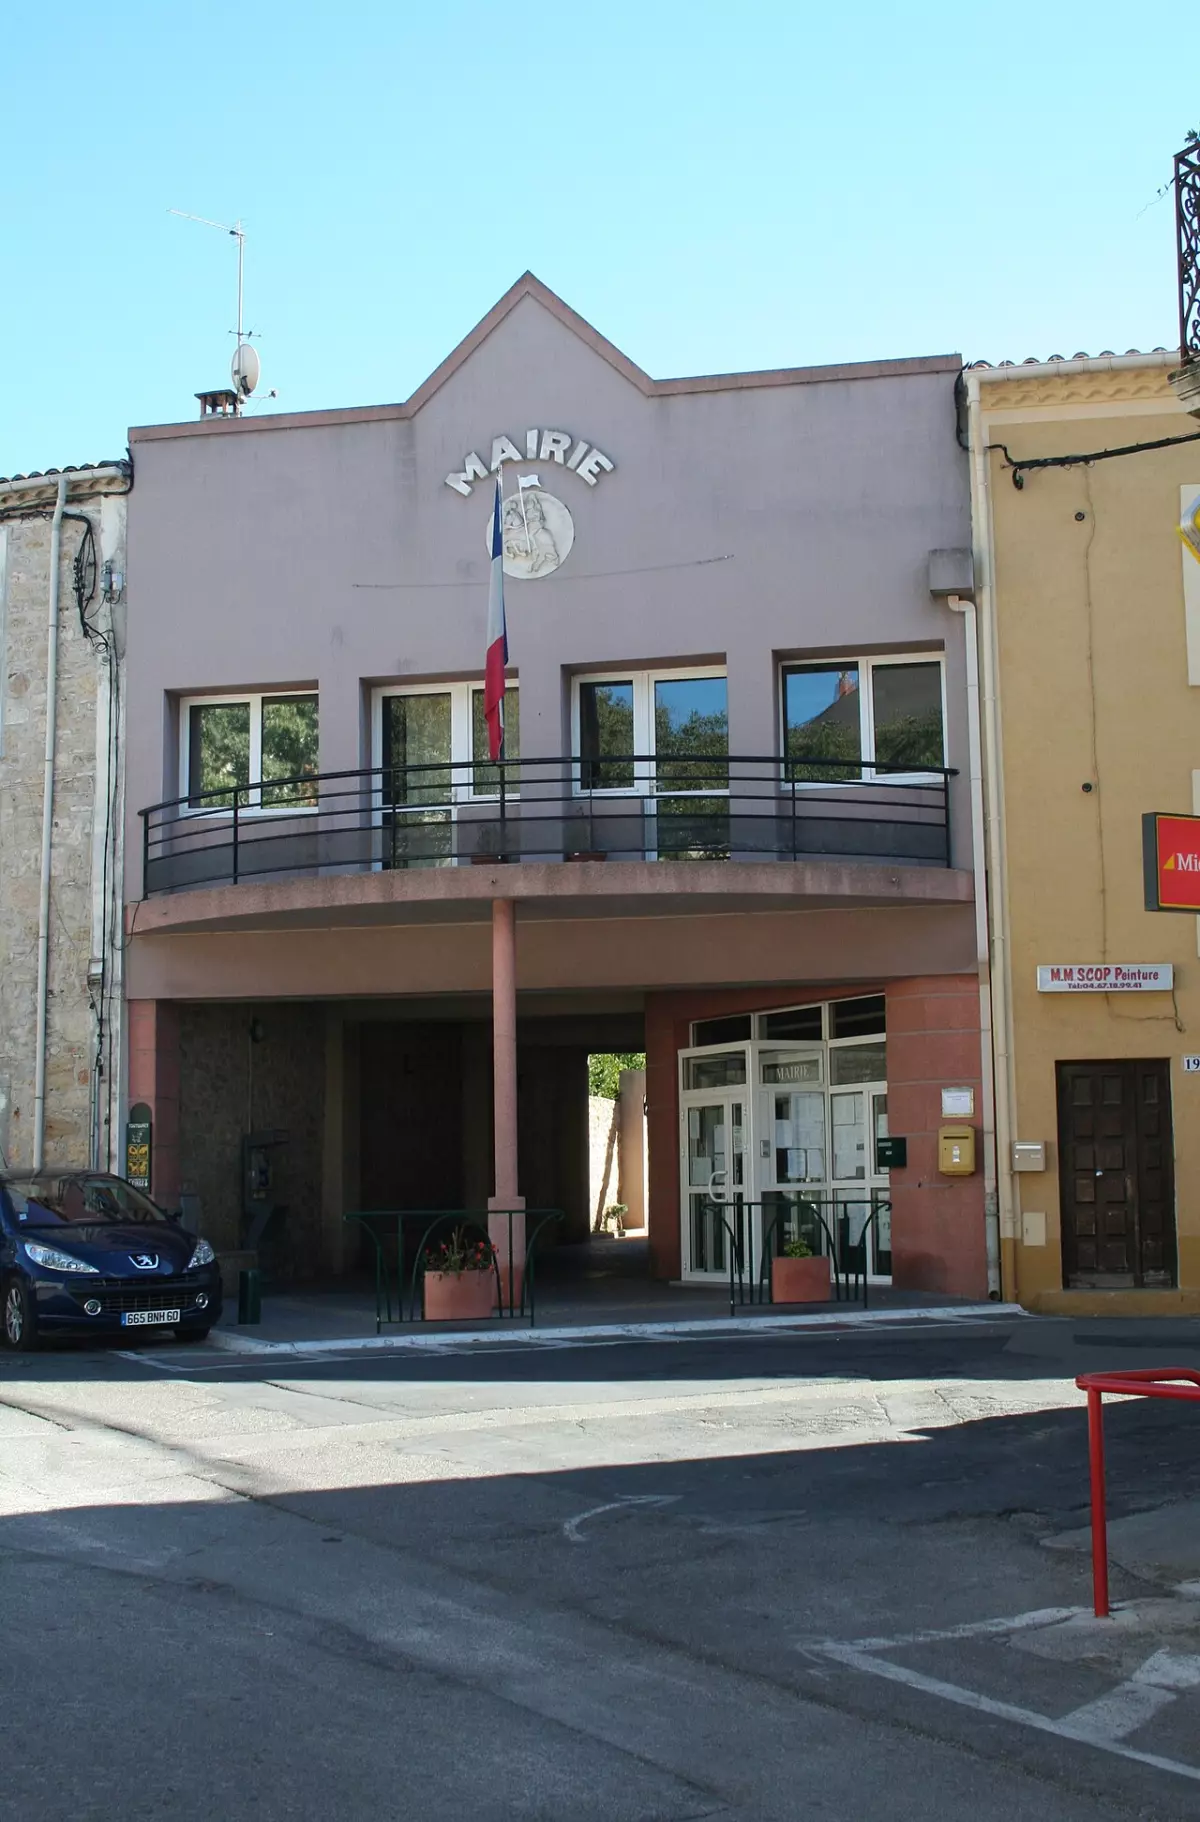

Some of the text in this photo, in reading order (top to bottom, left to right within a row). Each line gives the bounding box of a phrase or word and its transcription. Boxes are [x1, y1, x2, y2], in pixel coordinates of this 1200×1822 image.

[445, 429, 614, 496] MAIRIE
[1176, 853, 1200, 871] Mi
[1077, 967, 1111, 981] SCOP
[1114, 967, 1159, 980] Peinture
[775, 1064, 811, 1080] MAIRIE
[127, 1310, 178, 1324] 665 BNH 60
